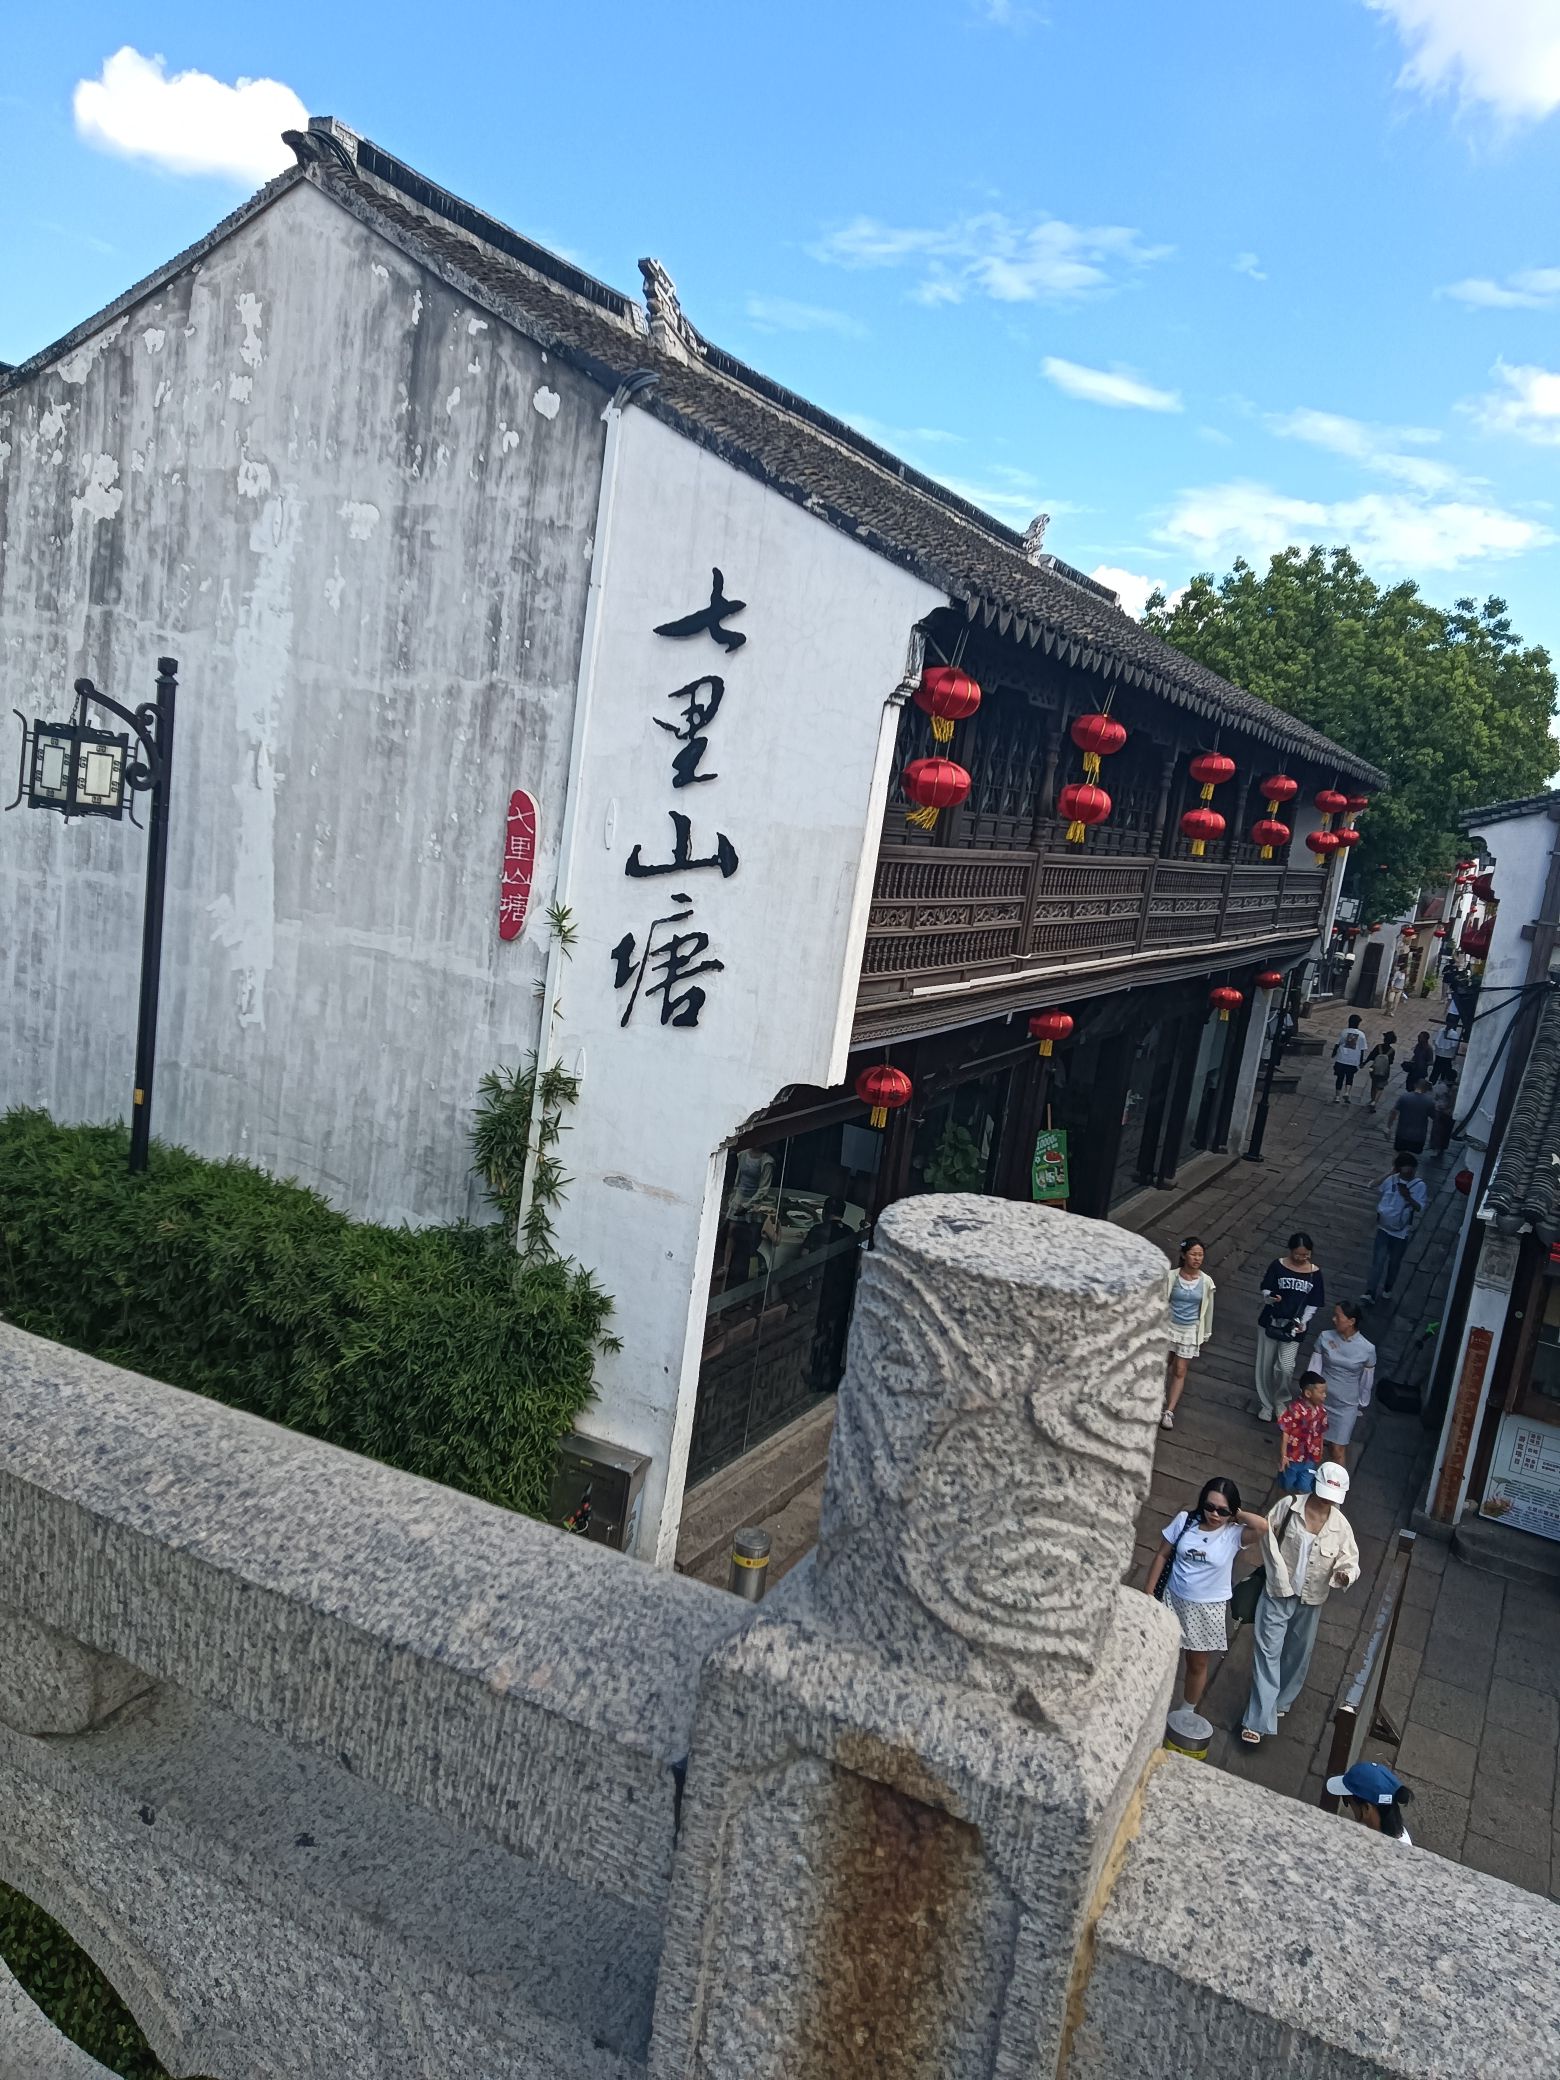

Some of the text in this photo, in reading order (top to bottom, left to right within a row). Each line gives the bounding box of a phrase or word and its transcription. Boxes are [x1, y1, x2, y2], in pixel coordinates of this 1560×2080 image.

[499, 806, 536, 924] 七里山塘
[611, 567, 747, 1028] 七里山塘
